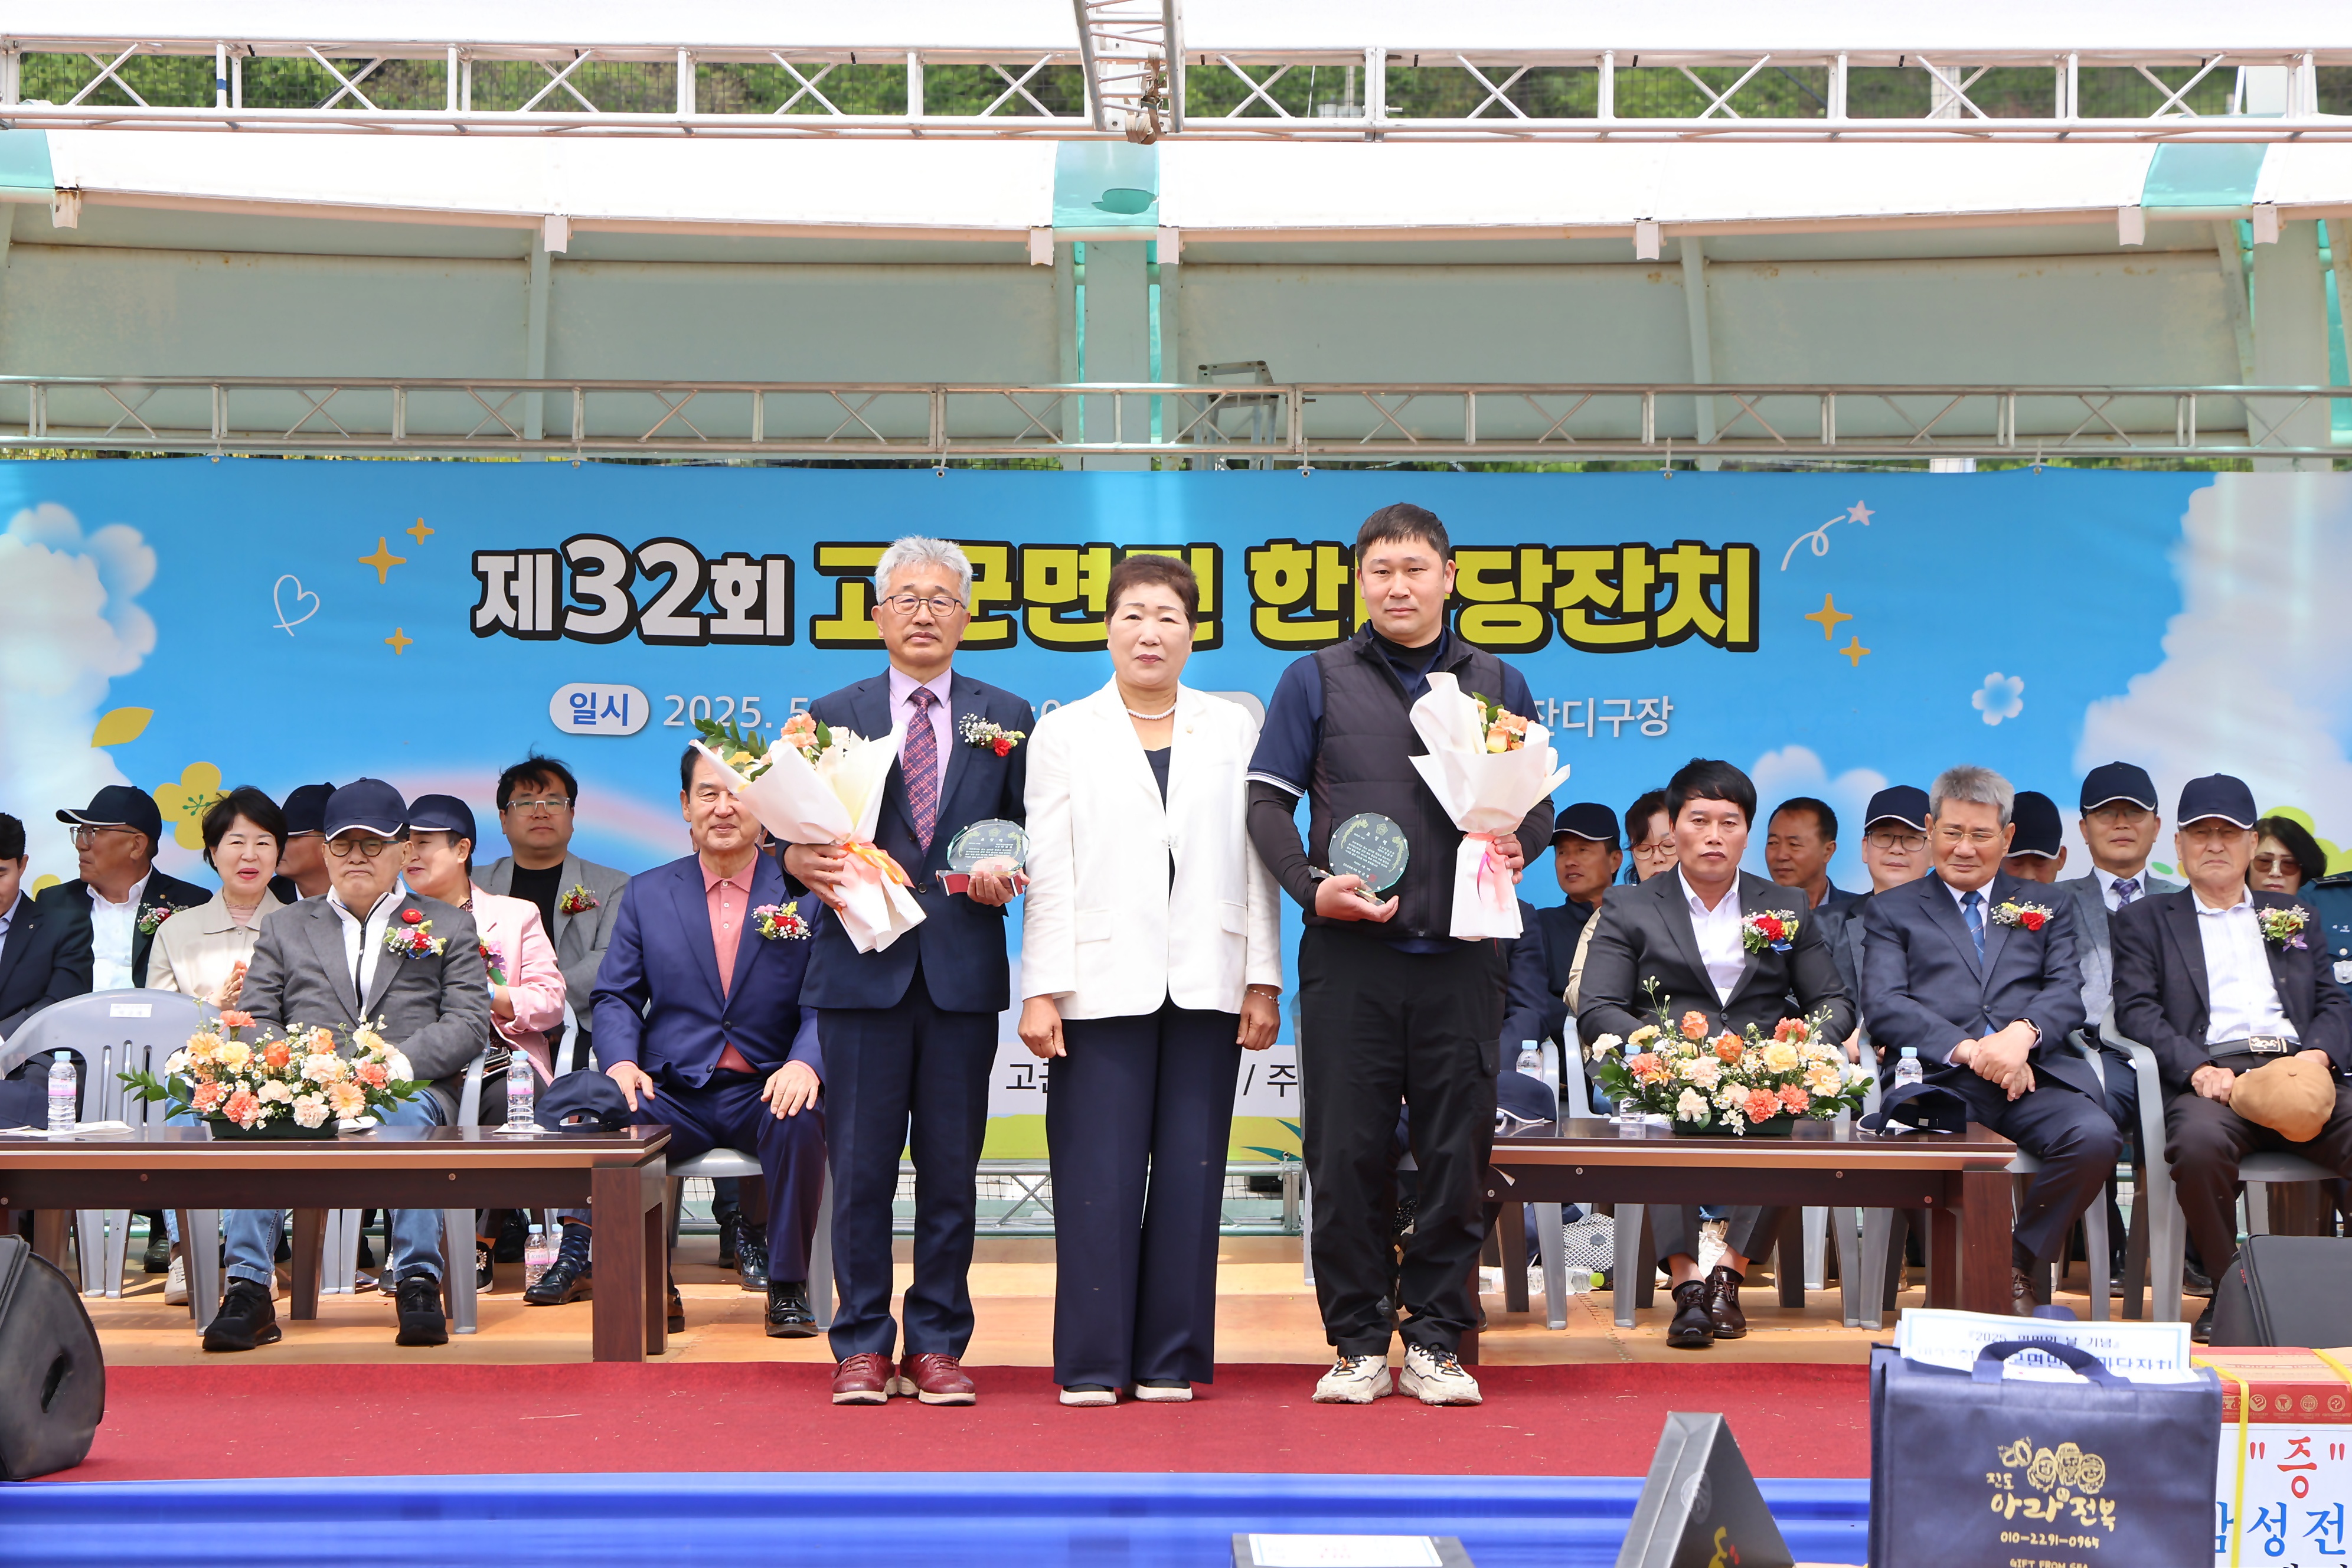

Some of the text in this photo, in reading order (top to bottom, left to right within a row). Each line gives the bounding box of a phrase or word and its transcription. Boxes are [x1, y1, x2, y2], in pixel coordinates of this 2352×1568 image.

[472, 535, 792, 642] 제32회
[1247, 541, 1755, 649] 한당잔치
[570, 692, 628, 726] 일시
[663, 694, 772, 728] 2025.
[1985, 1472, 2015, 1490] 진도
